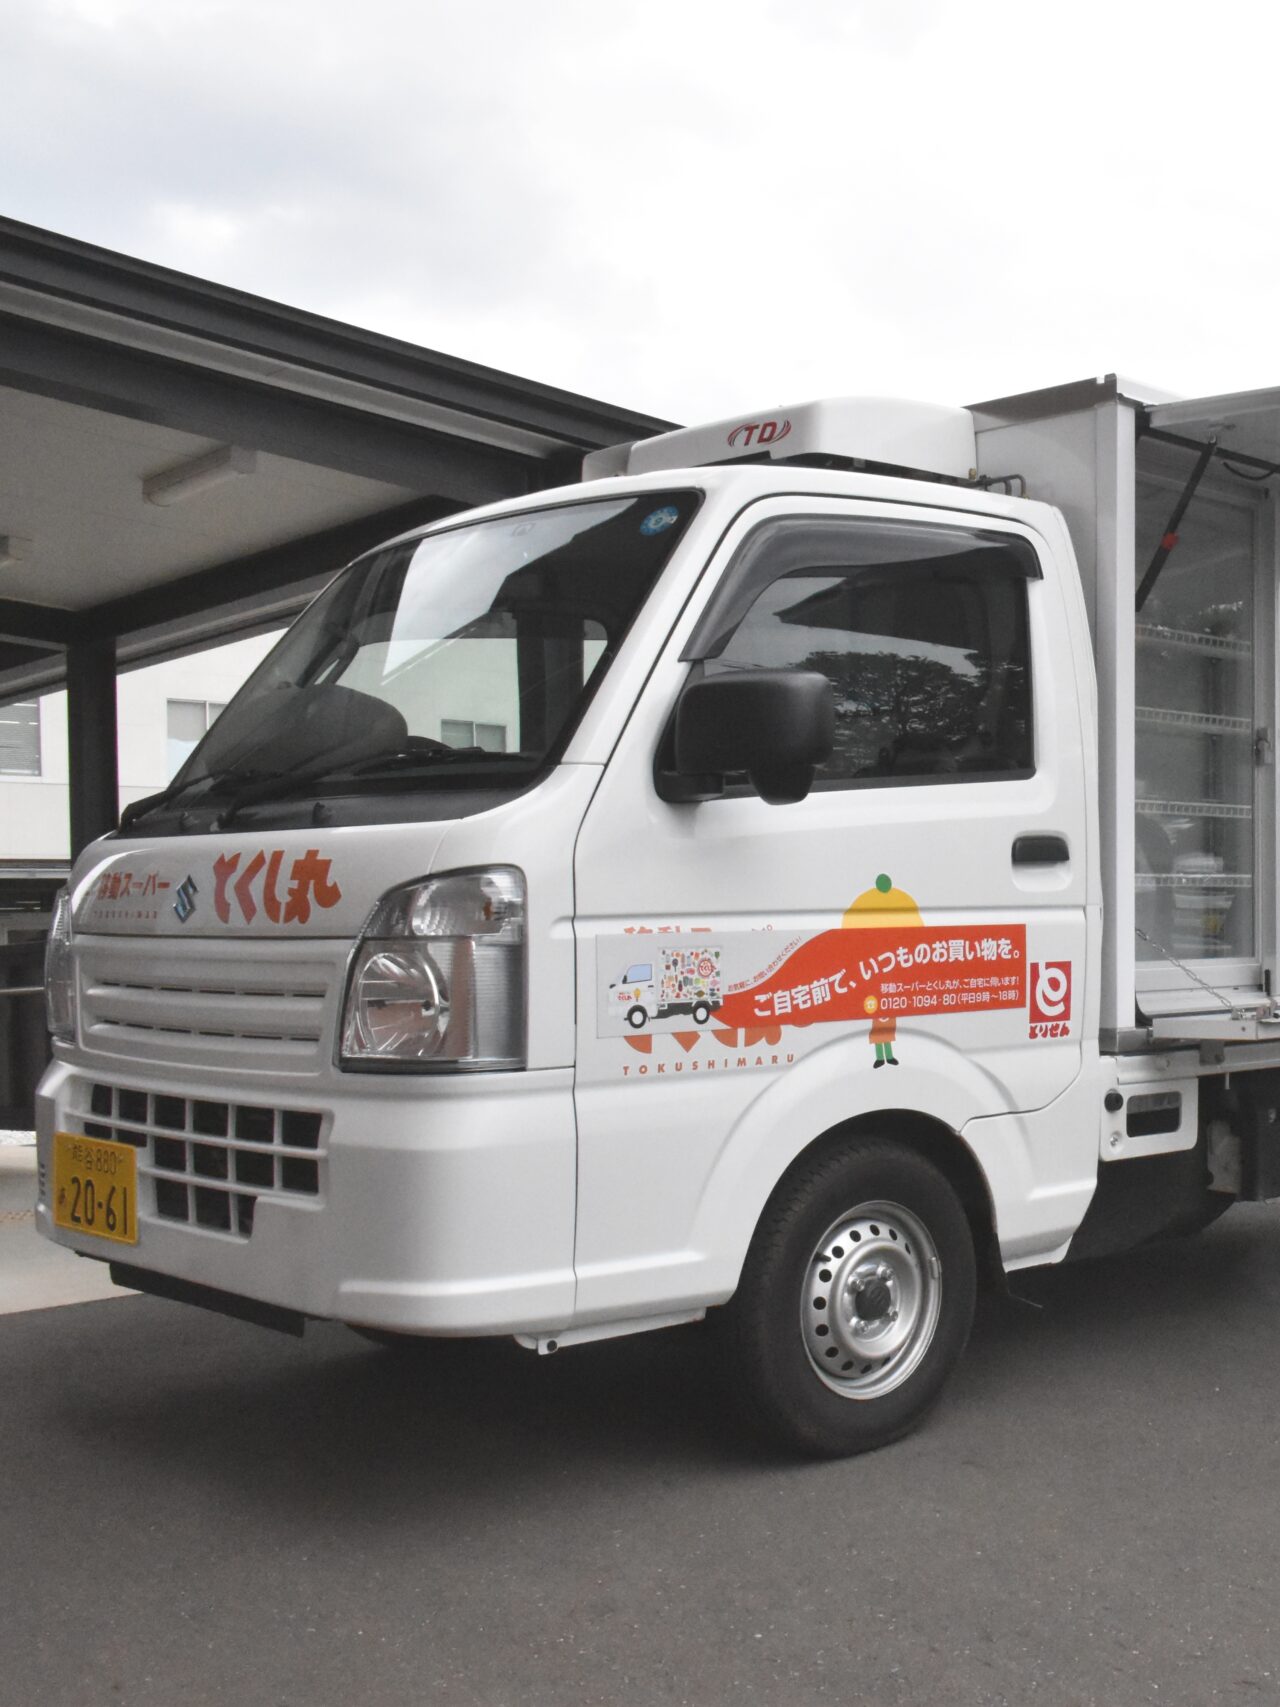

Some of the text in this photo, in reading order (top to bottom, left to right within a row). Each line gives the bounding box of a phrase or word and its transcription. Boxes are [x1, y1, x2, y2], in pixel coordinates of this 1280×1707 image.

[743, 421, 777, 447] TD
[213, 849, 342, 924] とくし丸
[622, 1054, 796, 1076] TOKUSHIMARU
